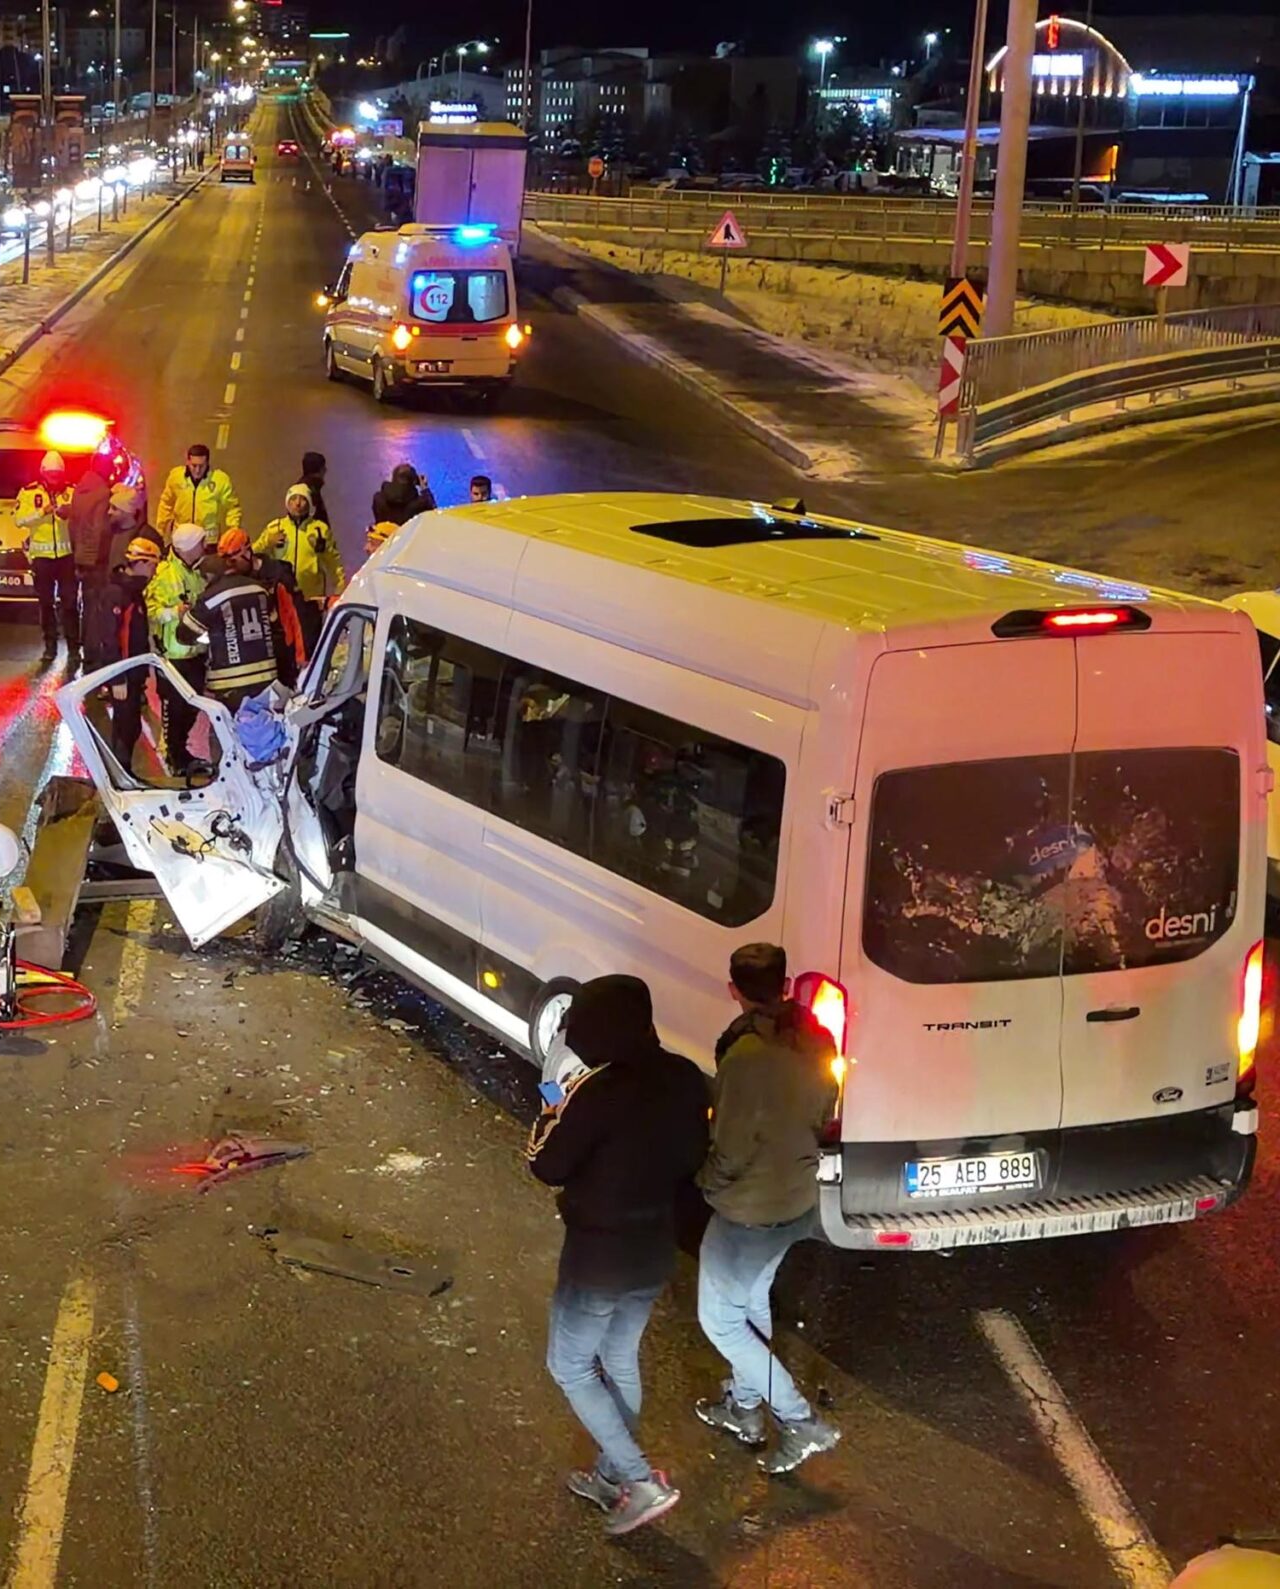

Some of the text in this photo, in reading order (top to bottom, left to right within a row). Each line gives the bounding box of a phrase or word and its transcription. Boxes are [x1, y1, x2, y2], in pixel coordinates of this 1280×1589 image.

[429, 293, 448, 305] 112
[1145, 904, 1216, 940] desni
[922, 1018, 1012, 1032] TRANSIT
[919, 1164, 942, 1187] 25
[955, 1160, 987, 1185] AEB
[999, 1156, 1032, 1180] 889
